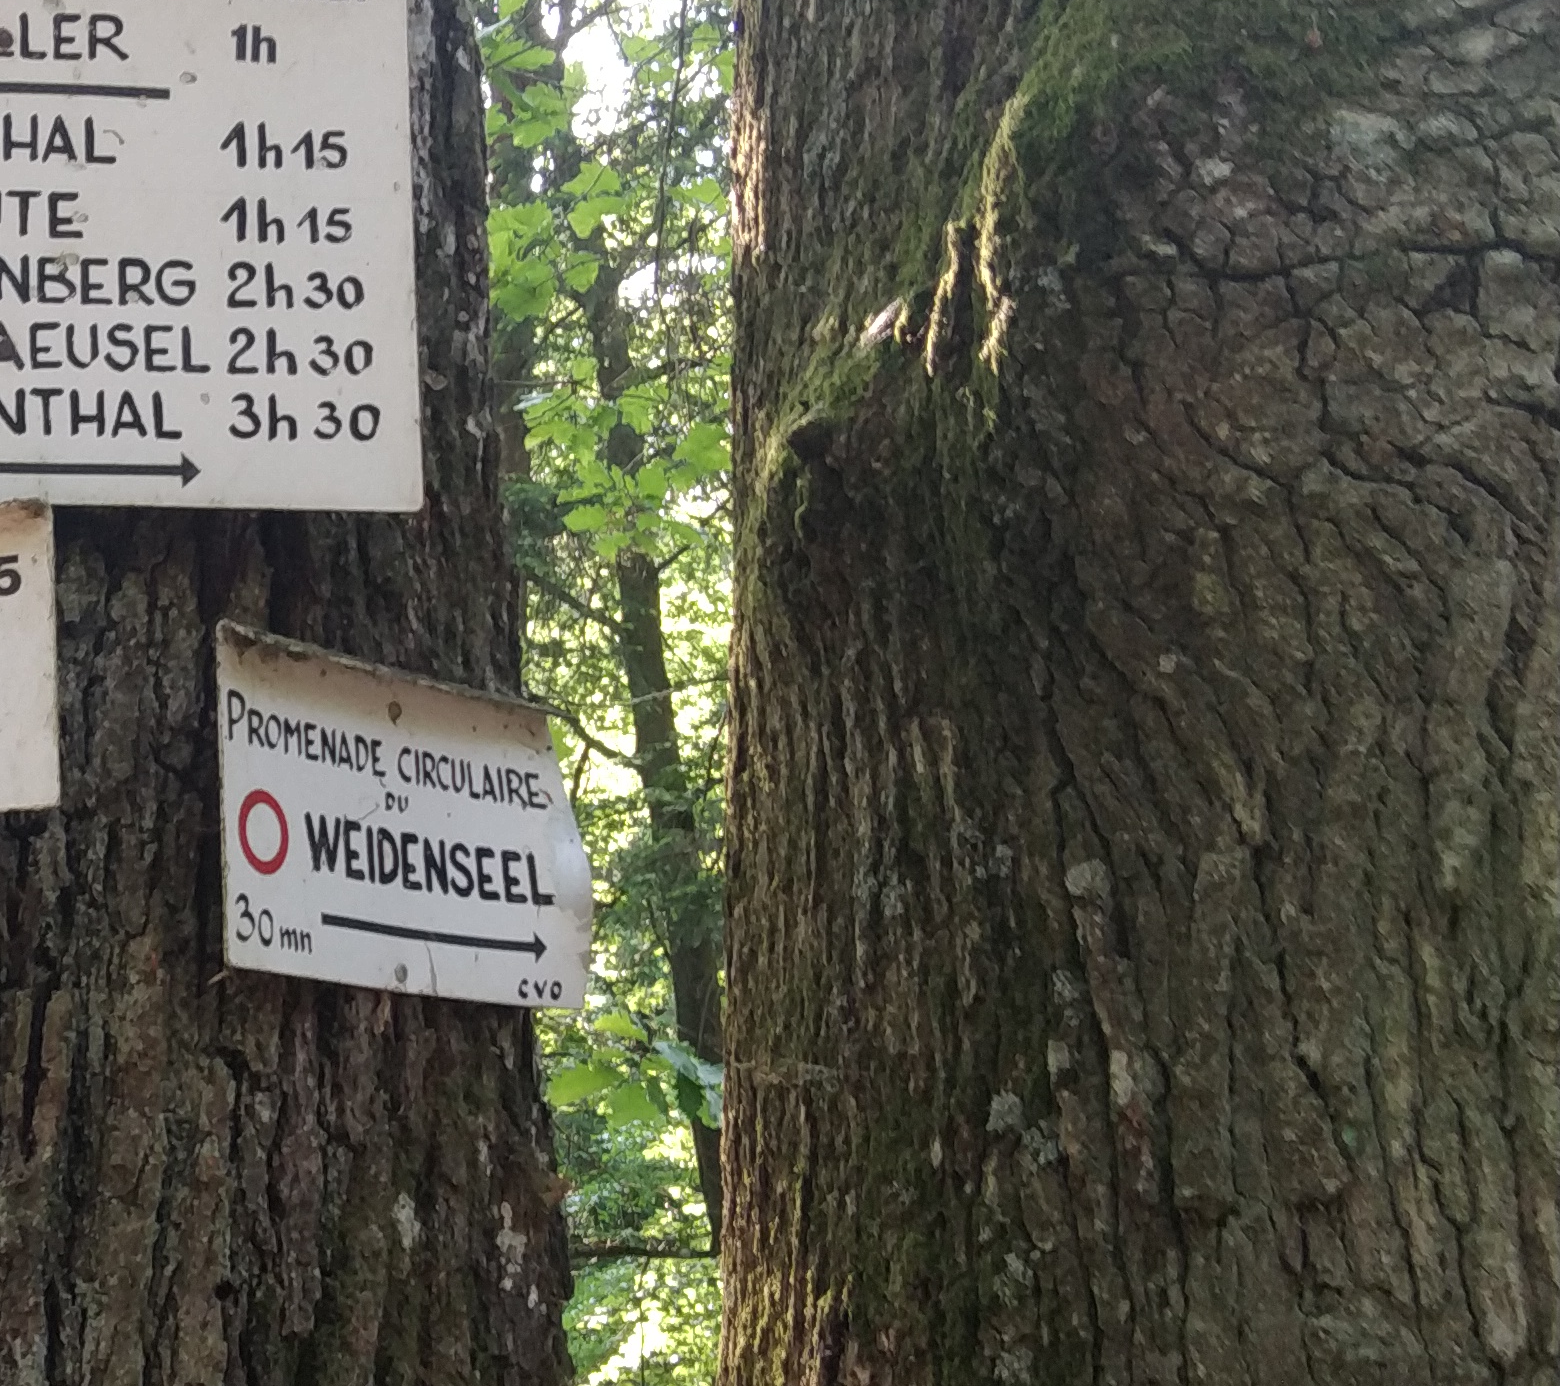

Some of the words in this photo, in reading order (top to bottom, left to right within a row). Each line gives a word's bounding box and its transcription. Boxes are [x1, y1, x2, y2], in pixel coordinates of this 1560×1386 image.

[231, 24, 278, 63] 1h
[225, 688, 387, 778] PROMENADE
[384, 791, 410, 812] DU
[304, 811, 556, 906] WEIDENSEEL
